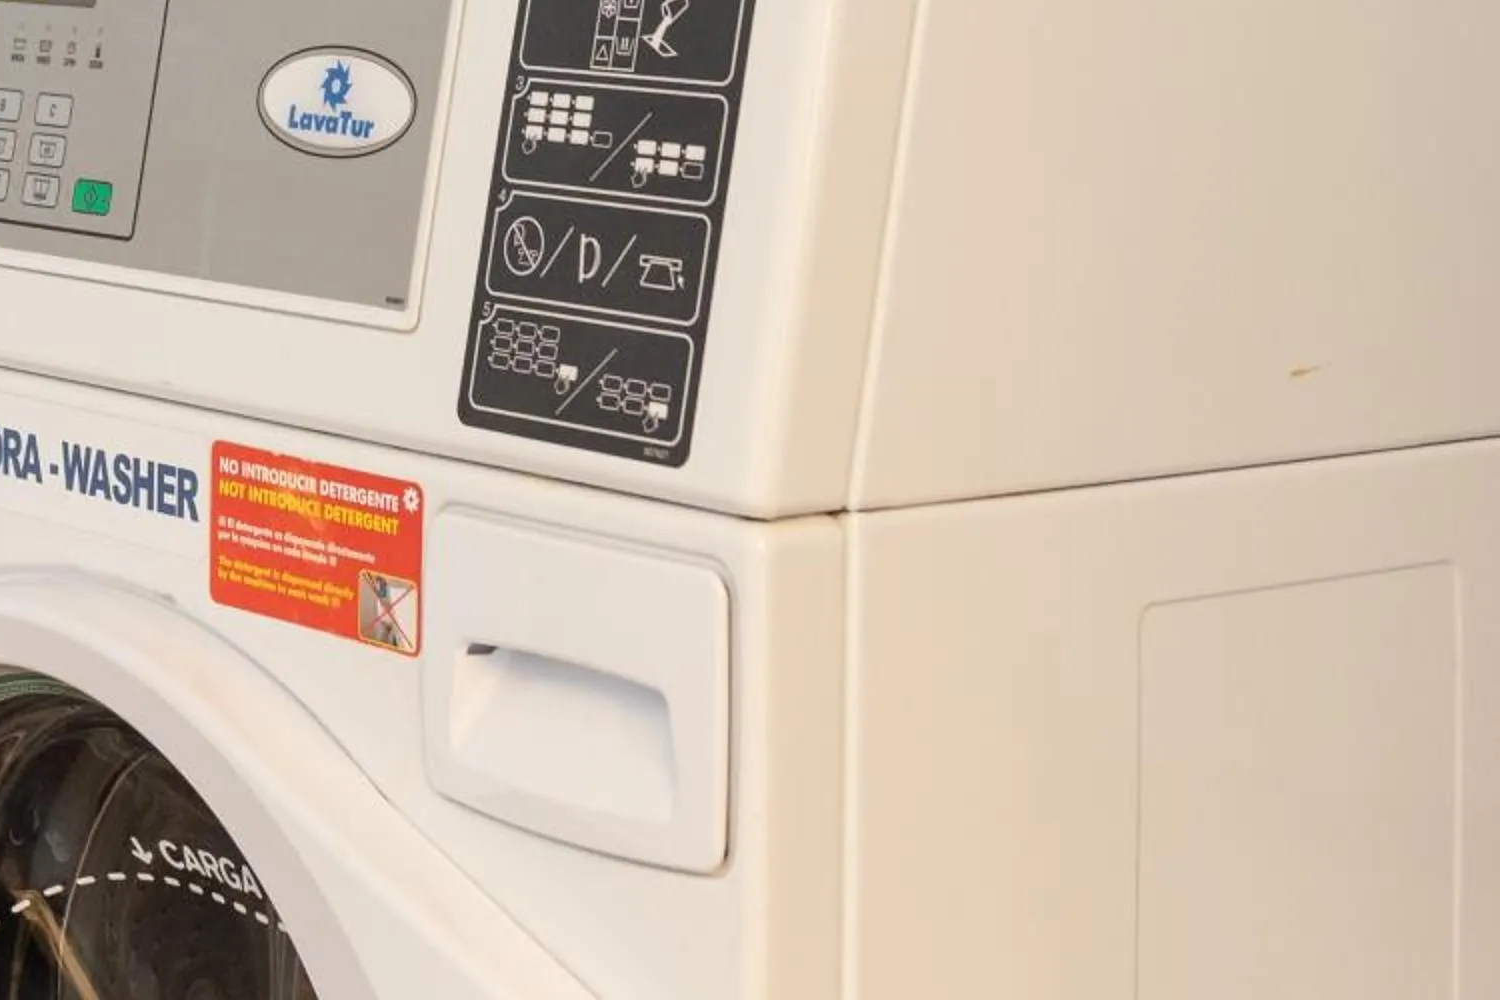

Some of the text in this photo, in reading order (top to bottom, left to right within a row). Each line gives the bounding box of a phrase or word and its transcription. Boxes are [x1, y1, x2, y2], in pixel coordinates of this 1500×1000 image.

[288, 104, 375, 138] LavaTur
[61, 440, 199, 522] WASHER
[218, 480, 399, 536] NOT INTRODUCE DETERGENT
[219, 456, 399, 513] NO INTRODUCIR DETERGENTE
[158, 839, 263, 899] CARGA
